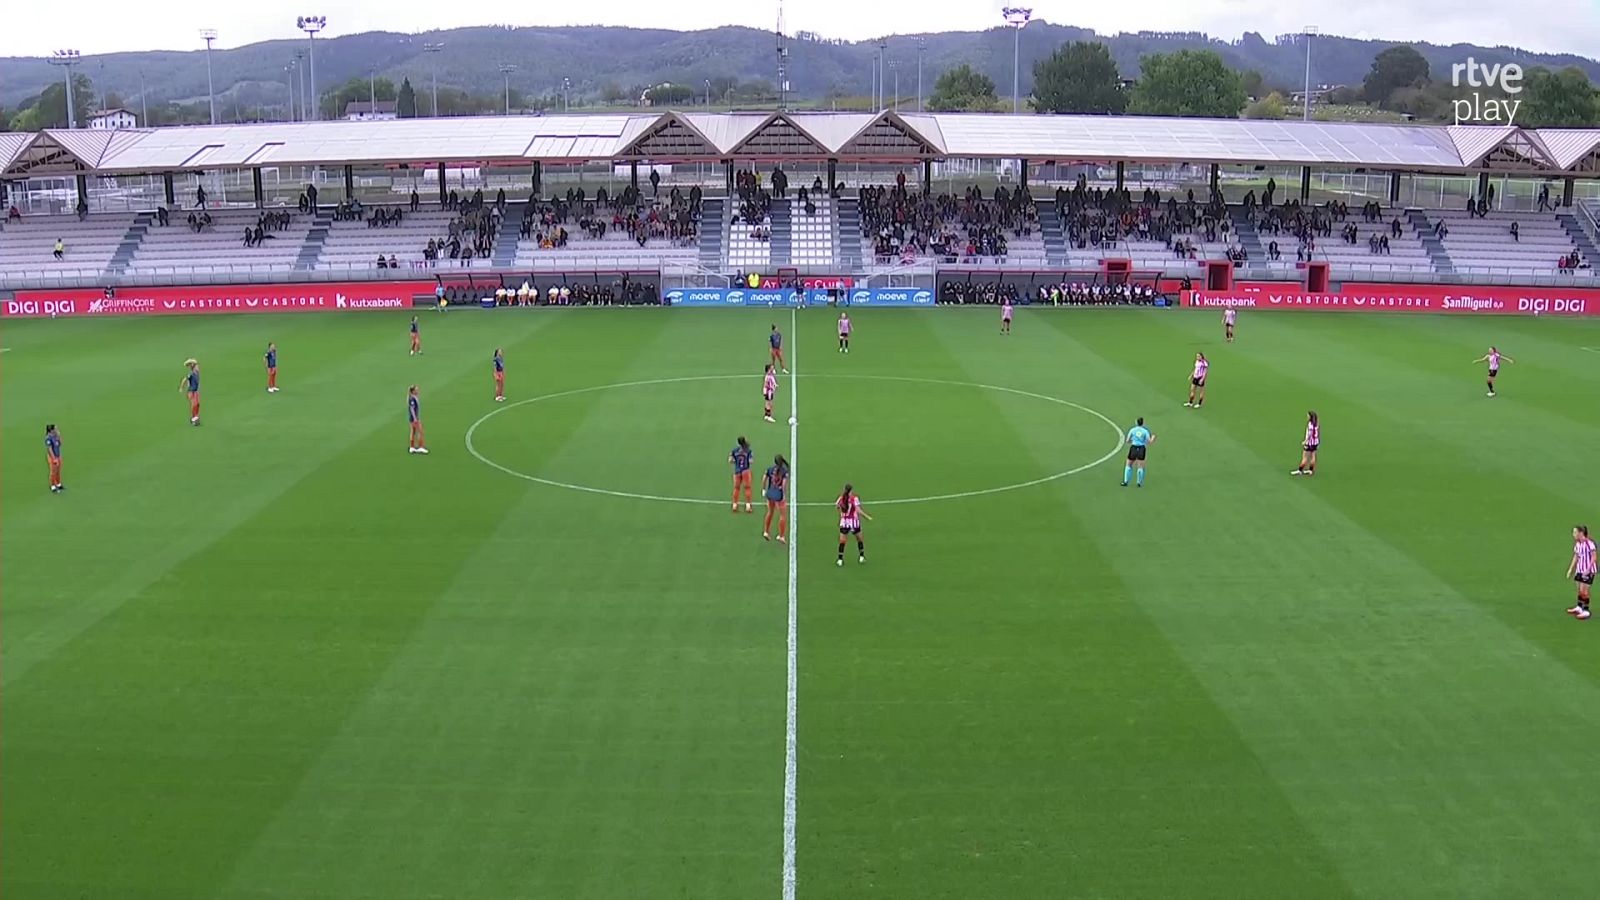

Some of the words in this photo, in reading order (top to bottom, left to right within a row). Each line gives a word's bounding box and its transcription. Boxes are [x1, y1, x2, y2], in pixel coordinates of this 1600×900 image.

[263, 297, 324, 306] CASTORE
[689, 292, 720, 301] moeve
[750, 292, 782, 301] moeve
[876, 292, 908, 301] moeve
[1203, 296, 1256, 307] kutxabank
[1286, 296, 1347, 305] CASTORE
[1370, 296, 1430, 307] CASTORE
[8, 301, 39, 314] DIGI
[44, 300, 75, 314] DIGI
[180, 298, 240, 308] CASTORE
[350, 298, 402, 308] kutxabank
[1518, 298, 1549, 311] DIGI
[1553, 299, 1585, 312] DIGI
